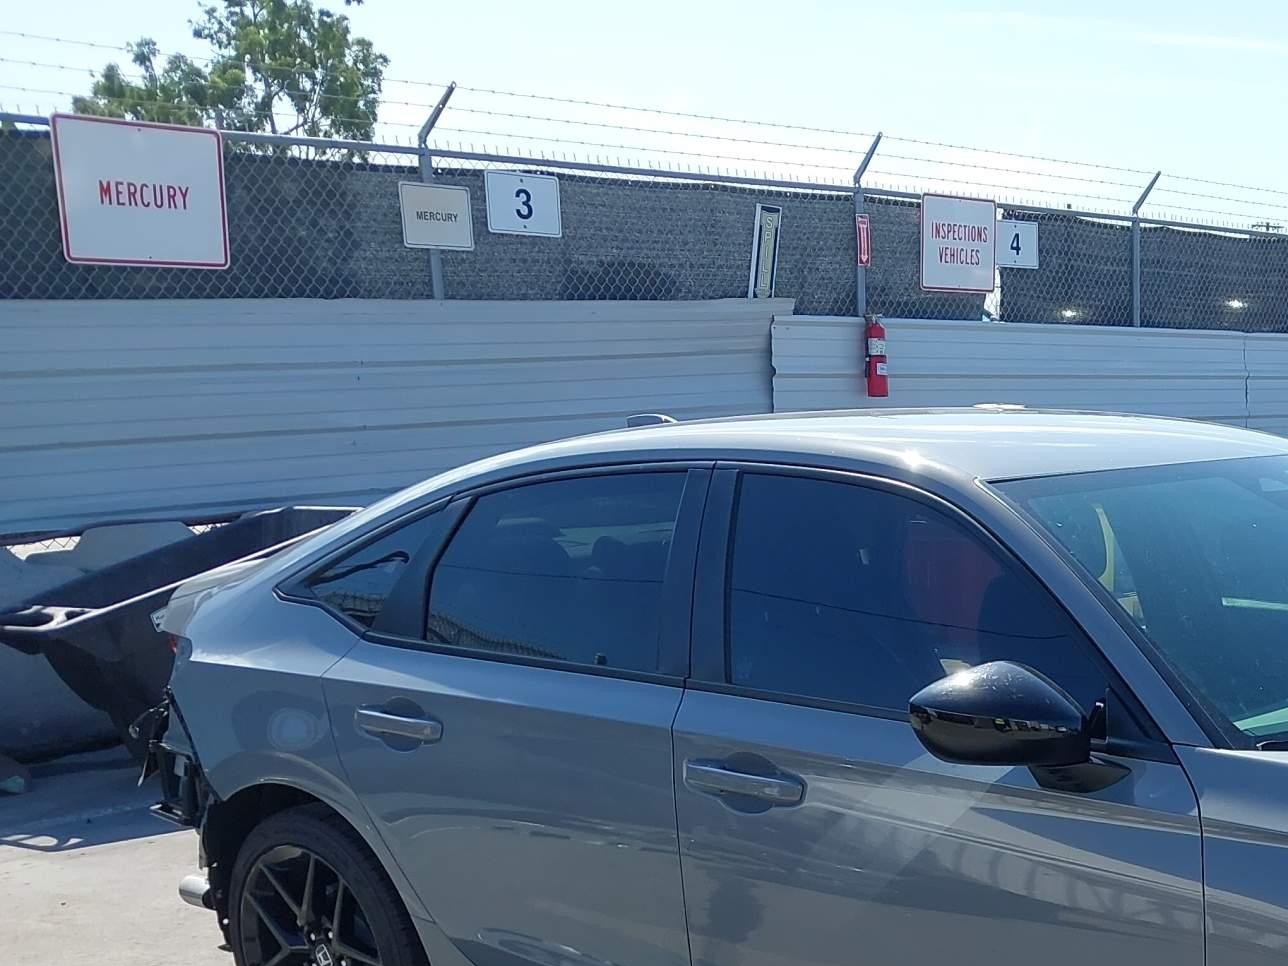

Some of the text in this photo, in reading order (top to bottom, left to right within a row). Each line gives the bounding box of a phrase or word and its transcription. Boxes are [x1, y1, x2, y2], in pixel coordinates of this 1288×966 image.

[98, 179, 190, 211] MERCURY
[514, 188, 534, 220] 3
[415, 210, 459, 223] MERCURY
[931, 221, 989, 243] INSPECTIONS
[760, 216, 773, 288] SPILL
[938, 246, 981, 266] VEHICLES
[1010, 233, 1022, 256] 4
